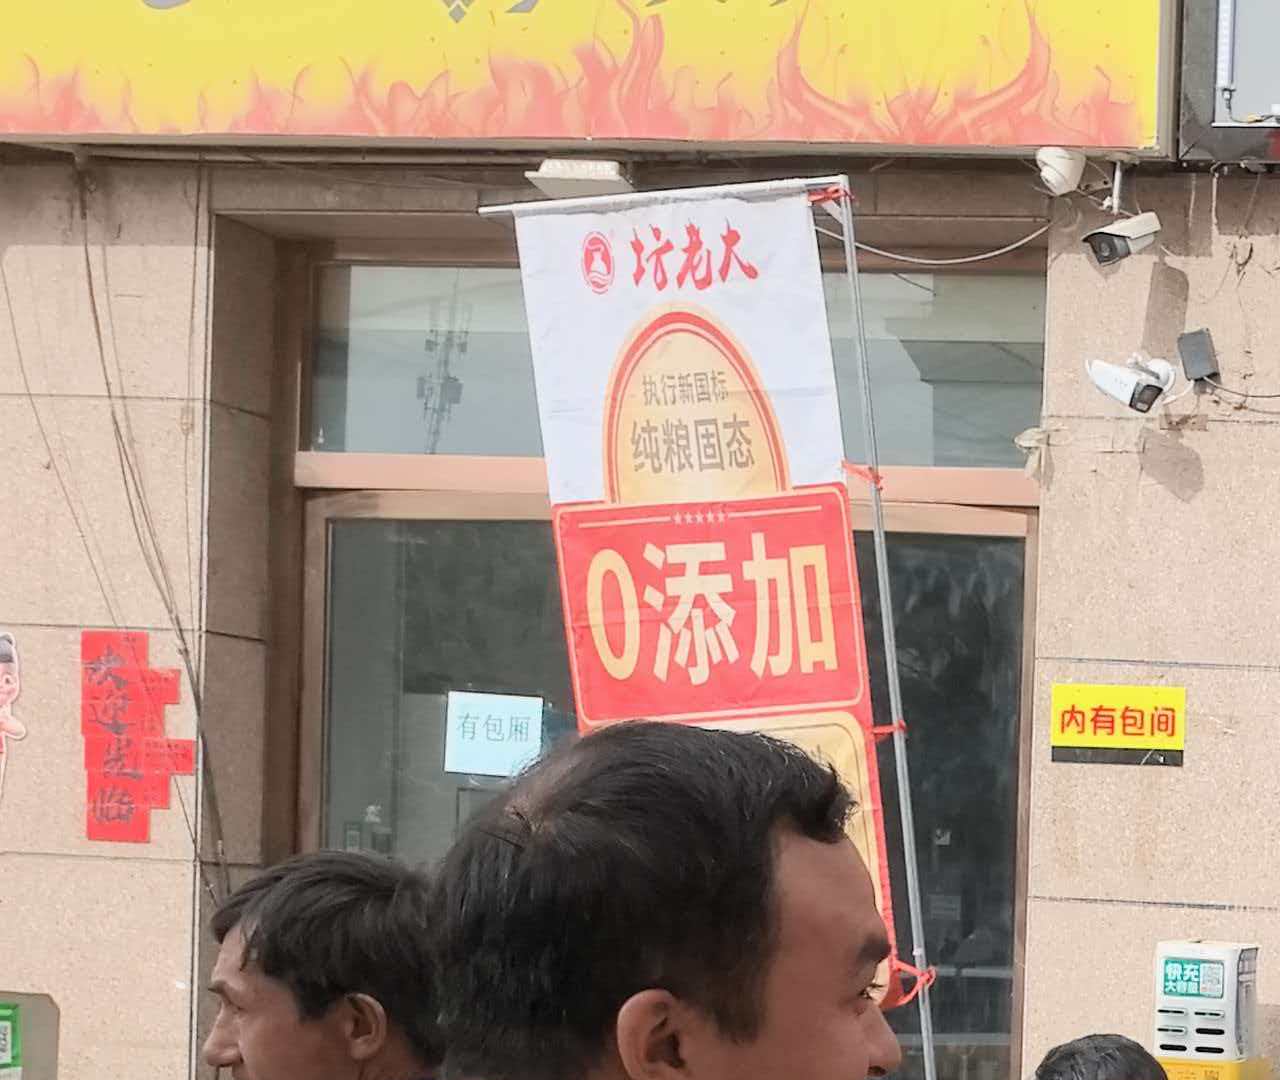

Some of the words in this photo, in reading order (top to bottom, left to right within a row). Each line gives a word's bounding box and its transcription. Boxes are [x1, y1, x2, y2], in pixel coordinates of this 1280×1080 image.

[642, 370, 729, 407] 执行新国标
[630, 412, 755, 475] 纯粮固态
[586, 532, 840, 686] 0添加
[457, 712, 531, 743] 有包厢
[1061, 704, 1176, 736] 内有包间
